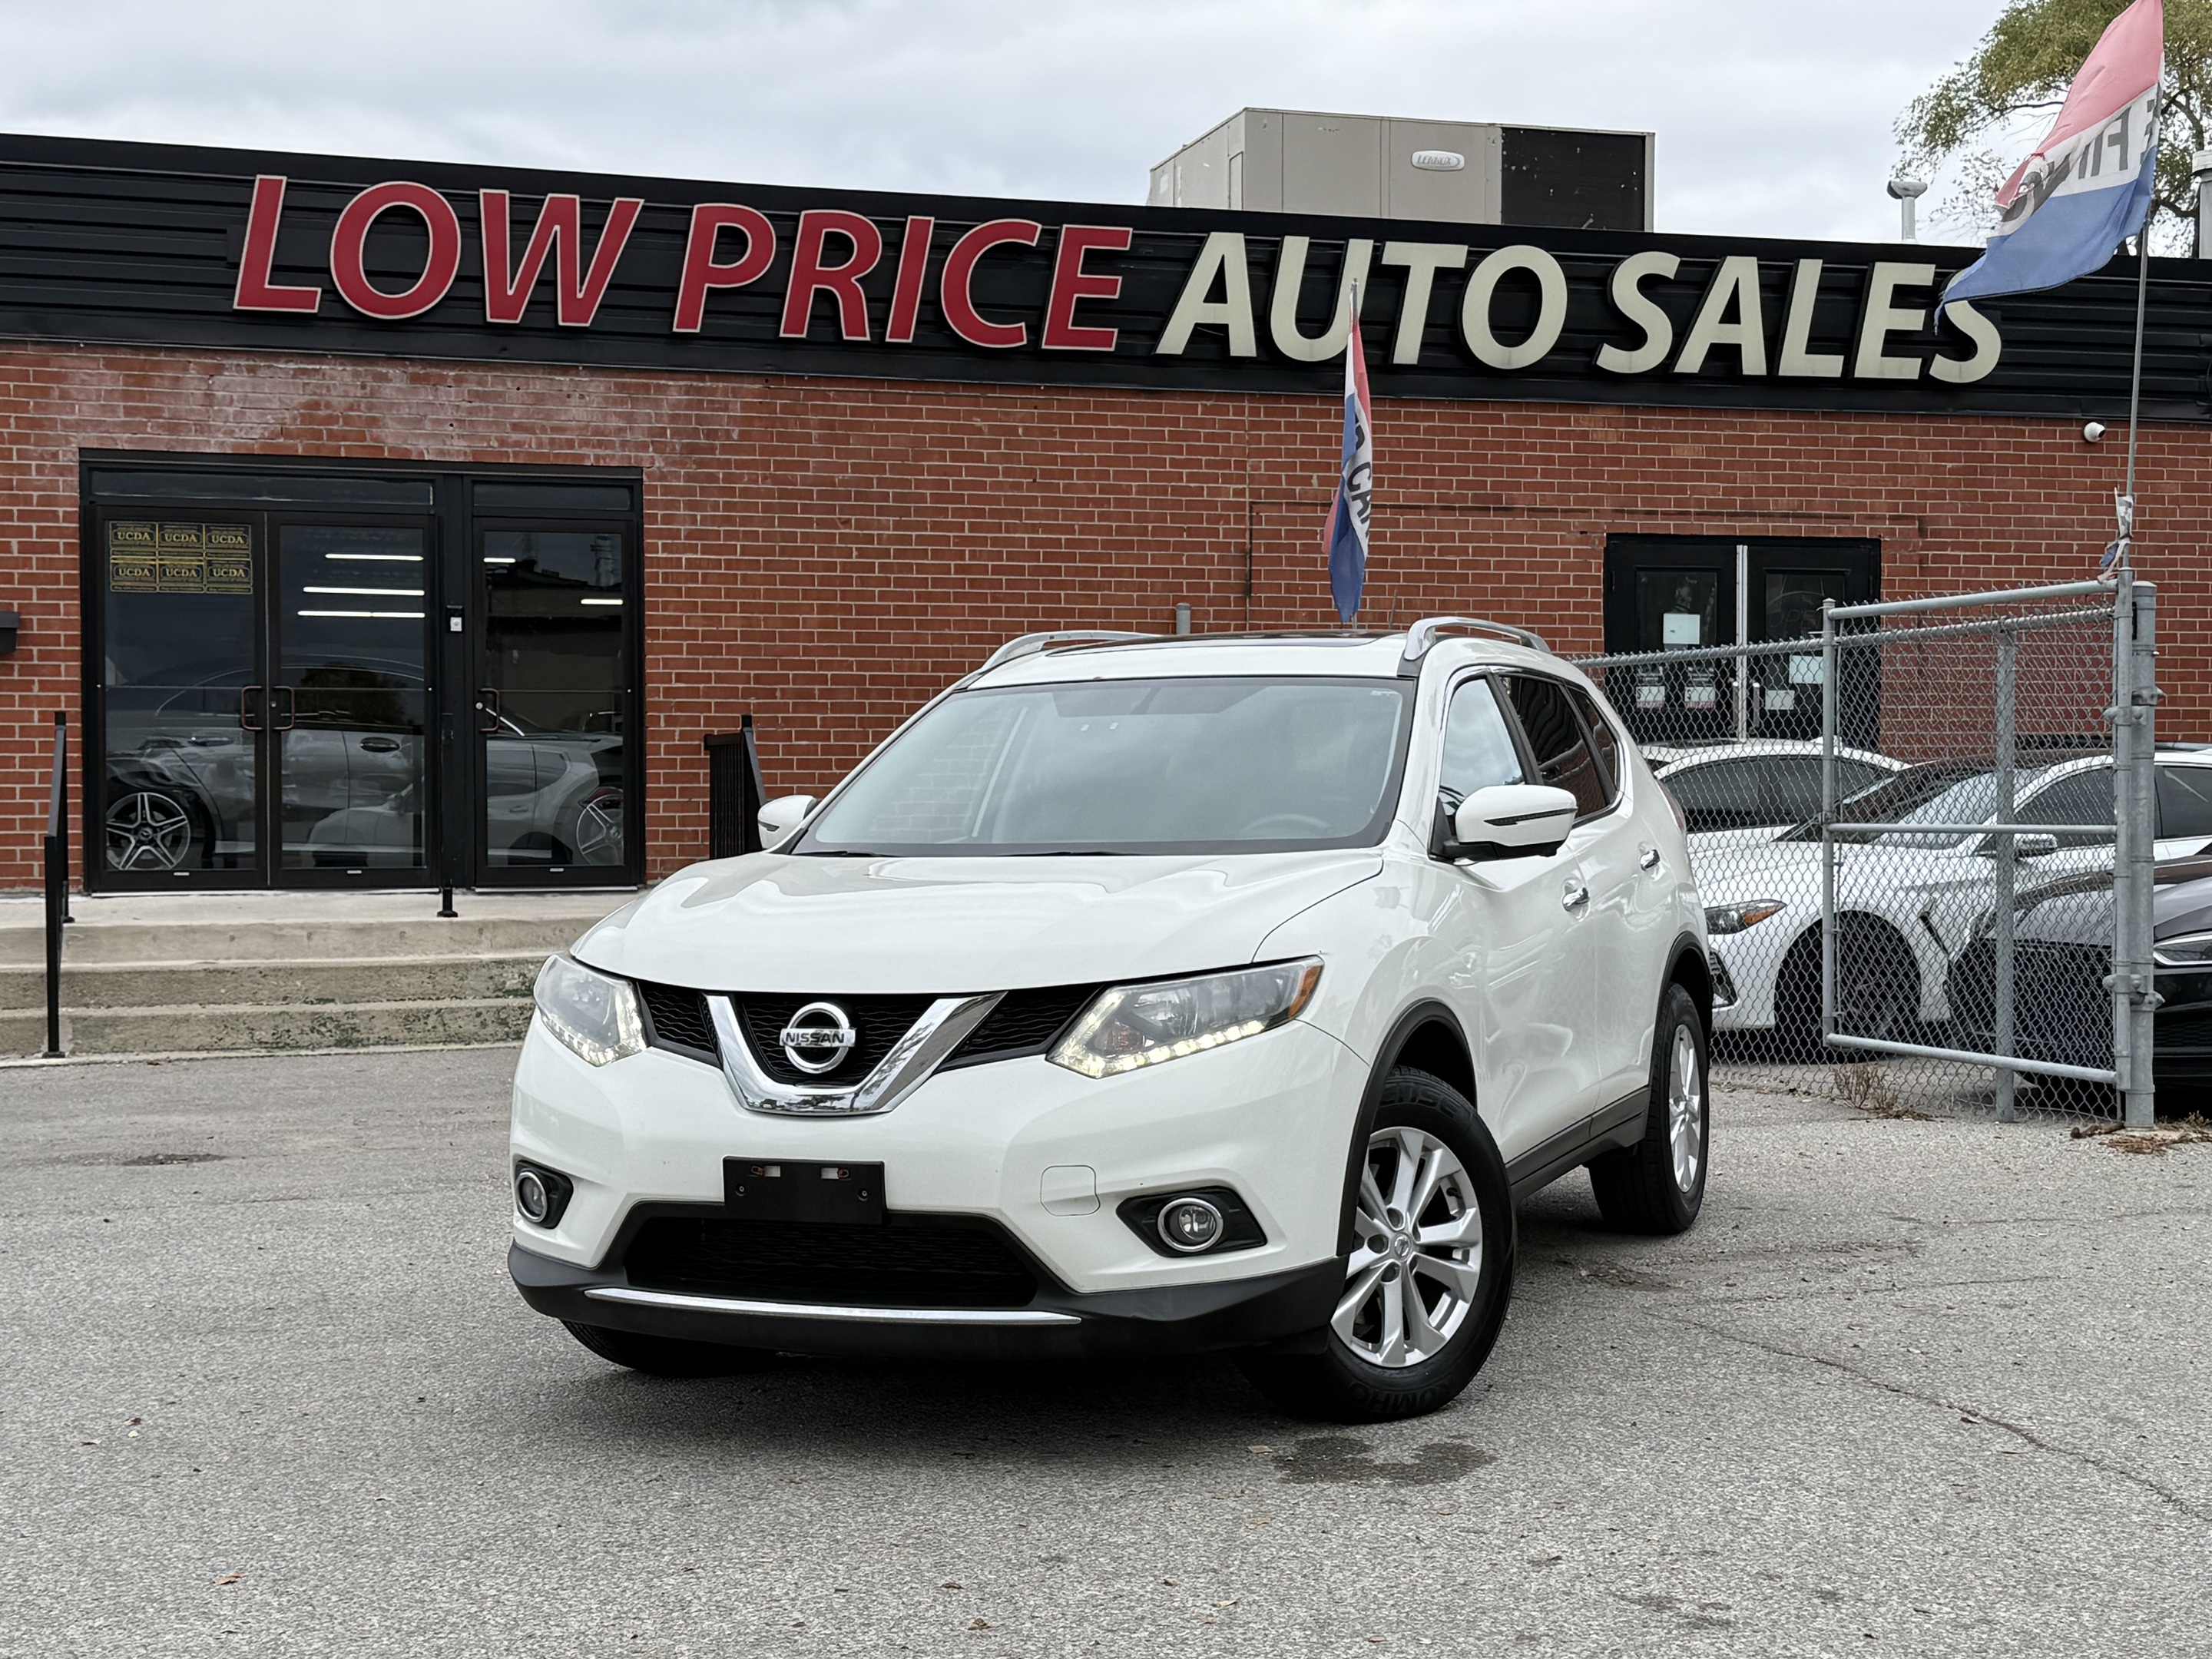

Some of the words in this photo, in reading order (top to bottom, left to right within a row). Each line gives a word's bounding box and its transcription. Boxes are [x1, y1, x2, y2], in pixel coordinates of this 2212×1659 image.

[233, 174, 644, 326] LOW
[672, 202, 1133, 351] PRICE
[1155, 231, 1568, 370] AUTO
[1595, 250, 2002, 384] SALES
[117, 531, 151, 541] UCDA
[164, 533, 198, 542] UCDA
[210, 535, 245, 544] UCDA
[118, 568, 151, 577] UCDA
[165, 568, 197, 578] UCDA
[213, 568, 246, 578] UCDA
[785, 1031, 845, 1044] NISSAN
